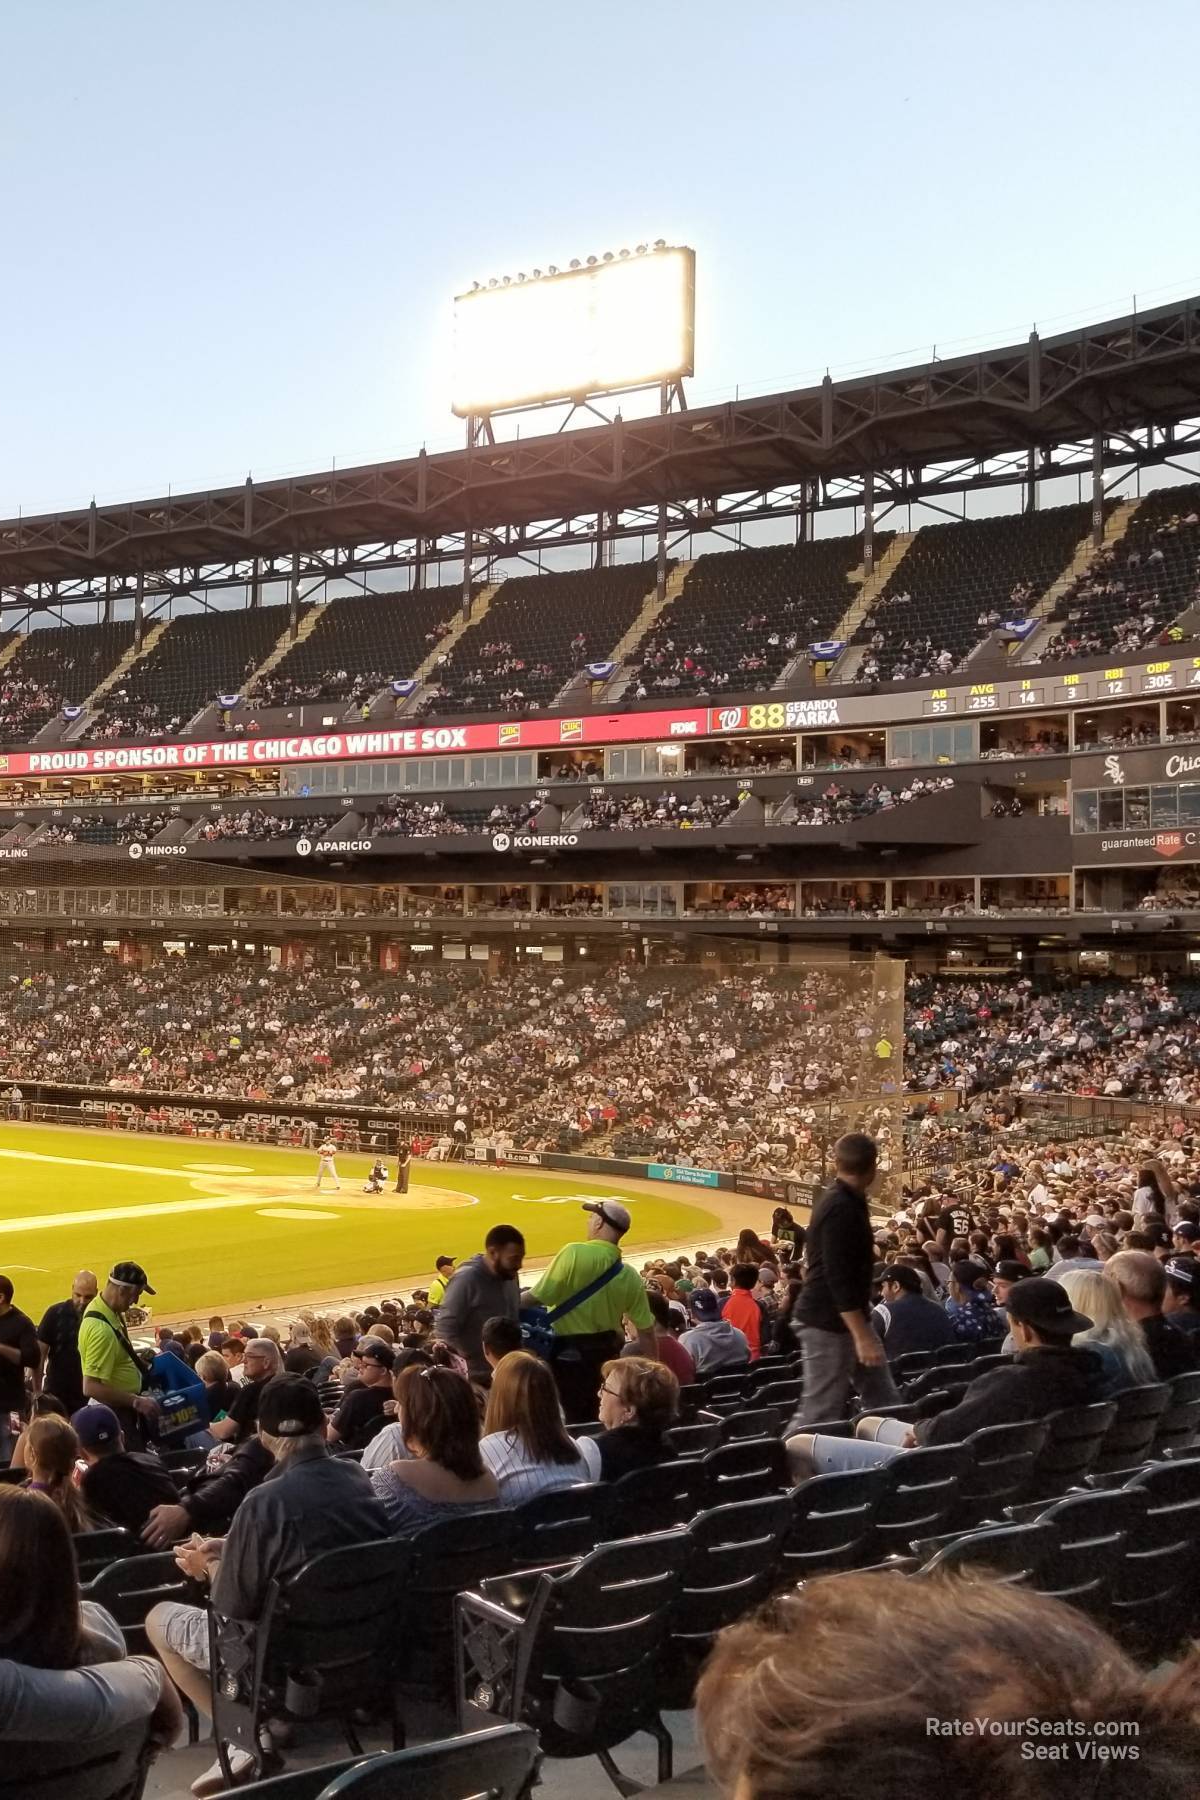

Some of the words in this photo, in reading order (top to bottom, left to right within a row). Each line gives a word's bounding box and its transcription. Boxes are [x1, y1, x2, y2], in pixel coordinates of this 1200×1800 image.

[931, 688, 947, 699] AB
[970, 684, 994, 695] AVG
[1022, 680, 1031, 690] H
[1063, 674, 1080, 685] HR
[1104, 668, 1123, 680] RBI
[1146, 662, 1171, 674] OBP
[932, 701, 948, 713] 55
[968, 695, 996, 709] .255
[1019, 691, 1036, 704] 14
[1067, 687, 1076, 699] 3
[1108, 681, 1123, 693] 12
[1144, 674, 1173, 690] .305
[785, 699, 838, 713] GERARDO
[749, 703, 785, 729] 88
[785, 710, 840, 726] PARRA
[29, 752, 89, 771] PROUD
[92, 747, 180, 768] SPONSOR
[183, 745, 208, 763] OF
[209, 742, 249, 761] THE
[253, 737, 342, 759] CHICAGO
[346, 731, 417, 754] WHITE
[421, 728, 466, 749] SOX
[299, 841, 308, 852] 11
[315, 840, 372, 852] APARICIO
[494, 837, 508, 849] 14
[514, 834, 578, 847] KONERKO
[1101, 835, 1155, 851] guaranteed
[1156, 834, 1180, 845] Rate
[145, 845, 187, 856] MINOSO
[80, 1099, 136, 1116] GEICO
[162, 1105, 220, 1122] GEICO
[243, 1112, 305, 1128] GEICO
[324, 1116, 359, 1127] GEICO
[953, 1219, 969, 1235] 56
